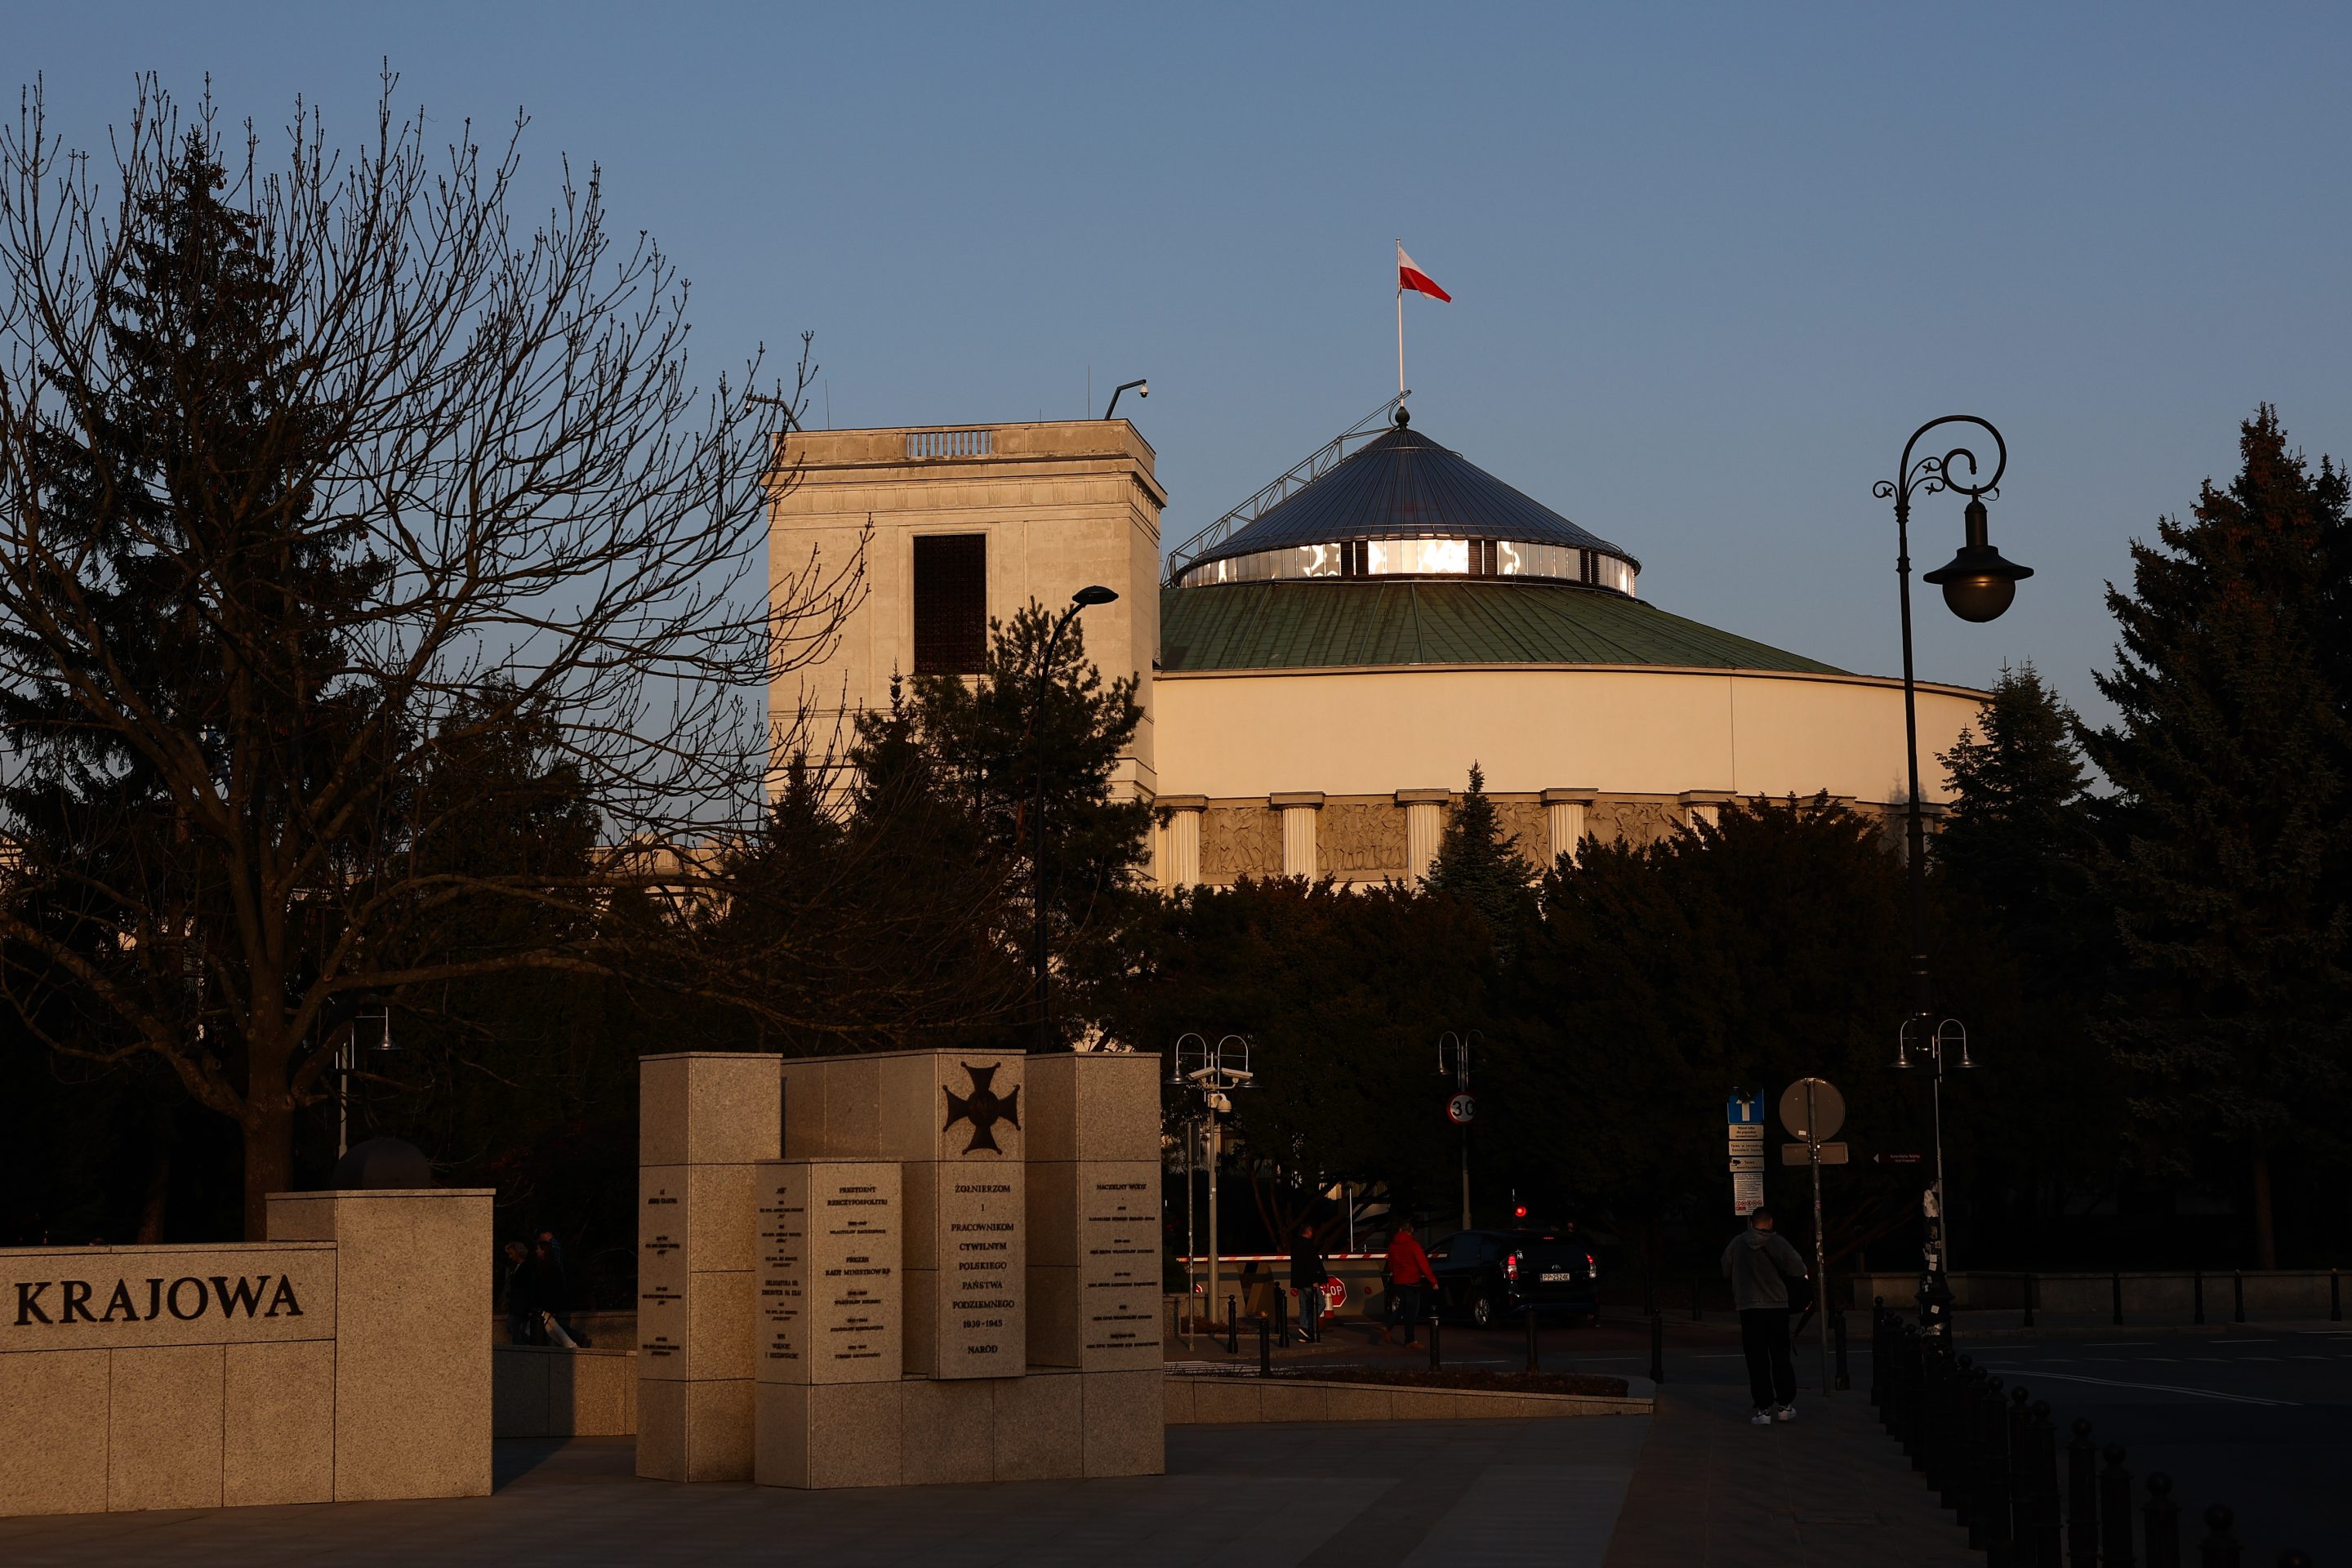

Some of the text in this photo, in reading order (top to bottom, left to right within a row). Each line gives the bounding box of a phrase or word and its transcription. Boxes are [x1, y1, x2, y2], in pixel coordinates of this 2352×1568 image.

[1452, 1100, 1475, 1116] 30
[954, 1184, 1011, 1193] ŻOŁNIERZOM
[951, 1223, 1014, 1232] PRACOWNIKOM
[959, 1242, 1007, 1251] CYWILNYM
[959, 1261, 1007, 1270] POLSKIEGO
[962, 1279, 1003, 1290] PAŃSTWA
[1320, 1285, 1343, 1296] SOP
[13, 1274, 304, 1325] KRAJOWA
[952, 1299, 1015, 1308] PODZIEMNEGO
[967, 1343, 998, 1354] NARÓD
